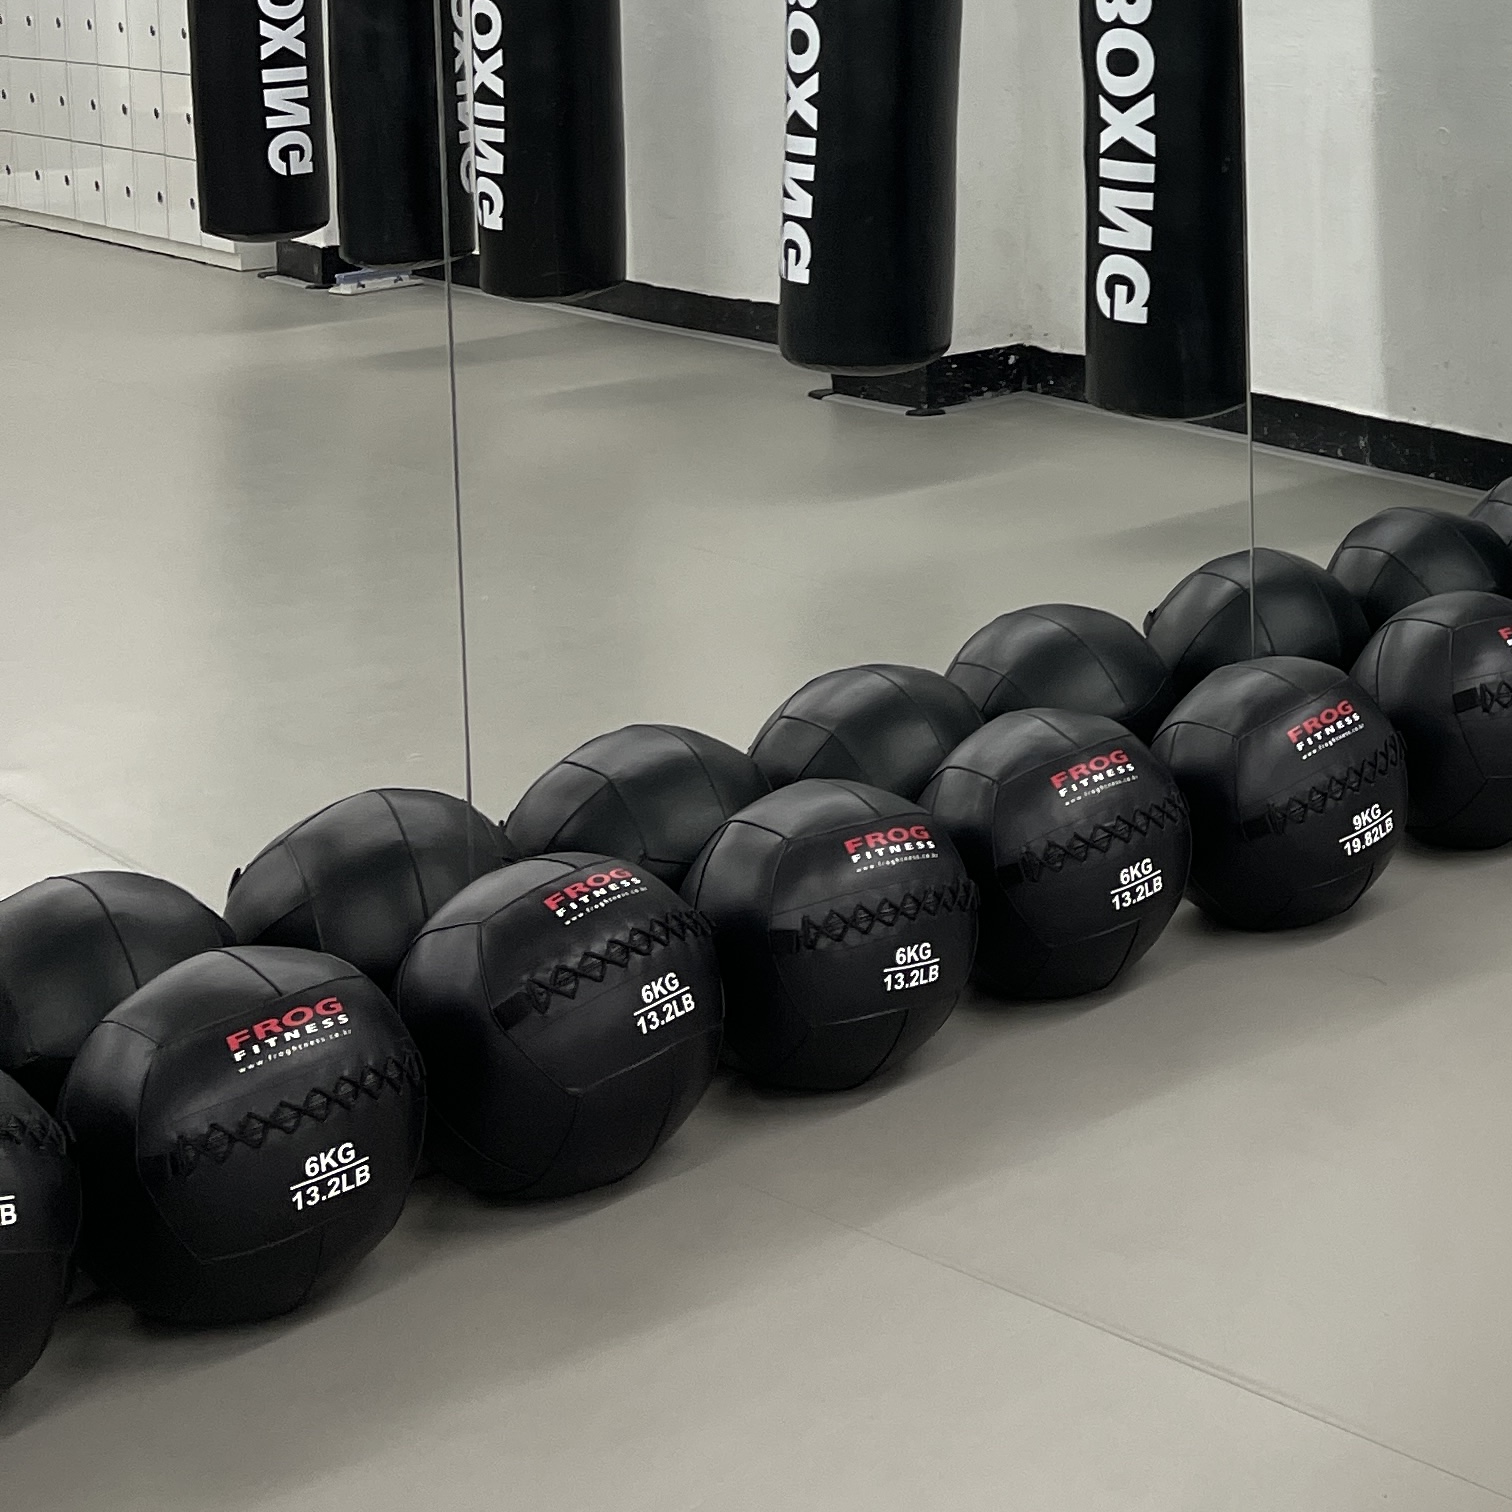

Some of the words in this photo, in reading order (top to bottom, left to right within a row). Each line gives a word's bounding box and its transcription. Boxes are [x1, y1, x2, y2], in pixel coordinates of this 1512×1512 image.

[1286, 699, 1355, 744] FROG
[1296, 712, 1361, 752] FITNESS
[1050, 749, 1130, 790] FROG
[1058, 763, 1135, 798] FITNESS
[1353, 803, 1382, 831] 9KG
[844, 825, 930, 854] FROG
[851, 840, 936, 864] FITNESS
[1343, 817, 1394, 856] 19.82LB
[543, 868, 633, 911] FROG
[1119, 857, 1153, 885] 6KG
[556, 877, 641, 917] FITNESS
[1111, 875, 1163, 910] 13.2LB
[895, 942, 932, 965] 6KG
[641, 972, 680, 1004] 6KG
[883, 964, 939, 991] 13.2LB
[226, 997, 344, 1052] FROG
[636, 993, 696, 1035] 13.2LB
[233, 1013, 349, 1062] FITNESS
[305, 1142, 356, 1177] 6KG
[291, 1164, 371, 1211] 13.2LB
